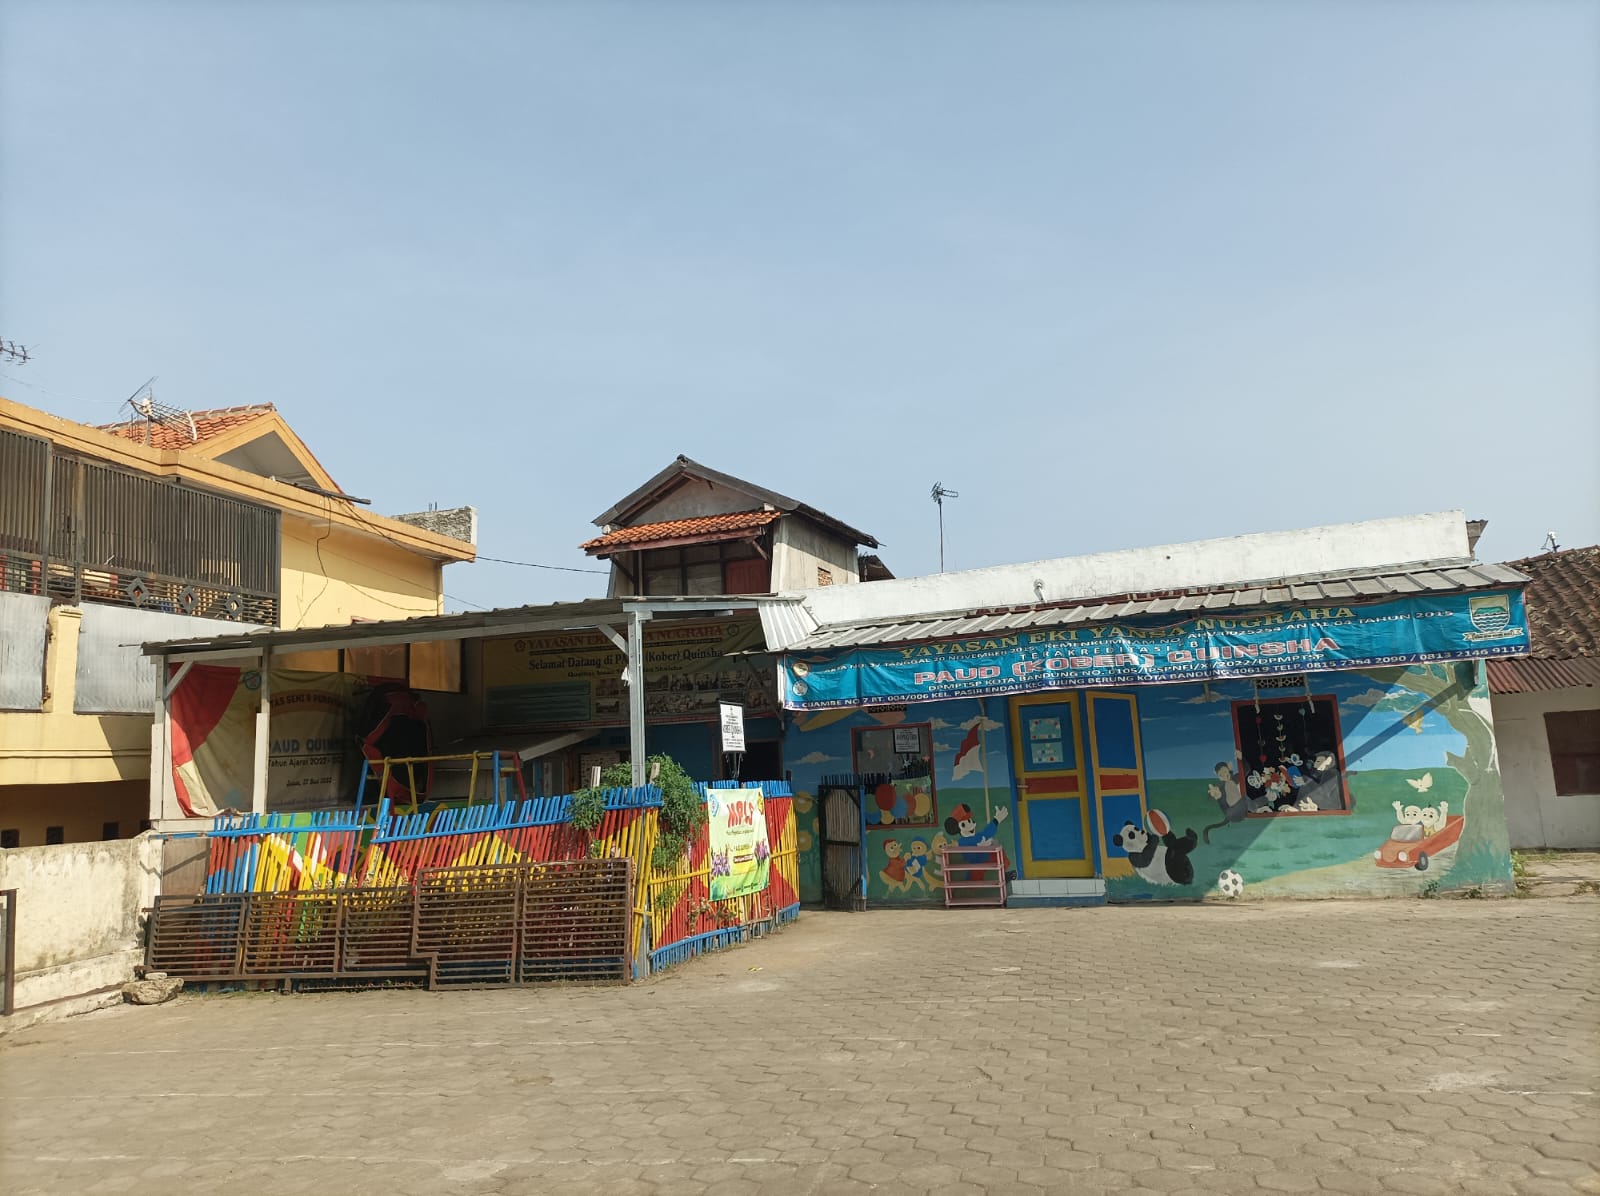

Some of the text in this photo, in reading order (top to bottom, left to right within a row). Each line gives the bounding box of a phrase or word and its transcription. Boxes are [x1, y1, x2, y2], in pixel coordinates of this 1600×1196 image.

[884, 658, 931, 668] TANGGAL
[948, 650, 1008, 660] NOVEMBER
[1359, 613, 1411, 624] TAHUN
[901, 635, 1018, 659] YAYASAN
[1029, 630, 1078, 644] EKI
[1195, 607, 1357, 631] NUGRAHA
[528, 658, 566, 670] Selamat
[567, 656, 602, 669] Datang
[914, 637, 1341, 685] PAUD (KOBER) QUINSHA
[928, 681, 983, 692] DPMPTSP
[986, 677, 1014, 685] KOTA
[1020, 670, 1078, 681] BANDUNG
[954, 689, 983, 697] PASIR
[986, 684, 1022, 693] ENDAH
[1048, 678, 1085, 686] UJUNG
[1088, 675, 1134, 684] BERUNG
[1169, 669, 1230, 680] BANDUNG
[1232, 666, 1270, 674] 40619
[1375, 655, 1407, 664] 2090
[1492, 645, 1526, 654] 9117
[269, 738, 299, 753] AUD
